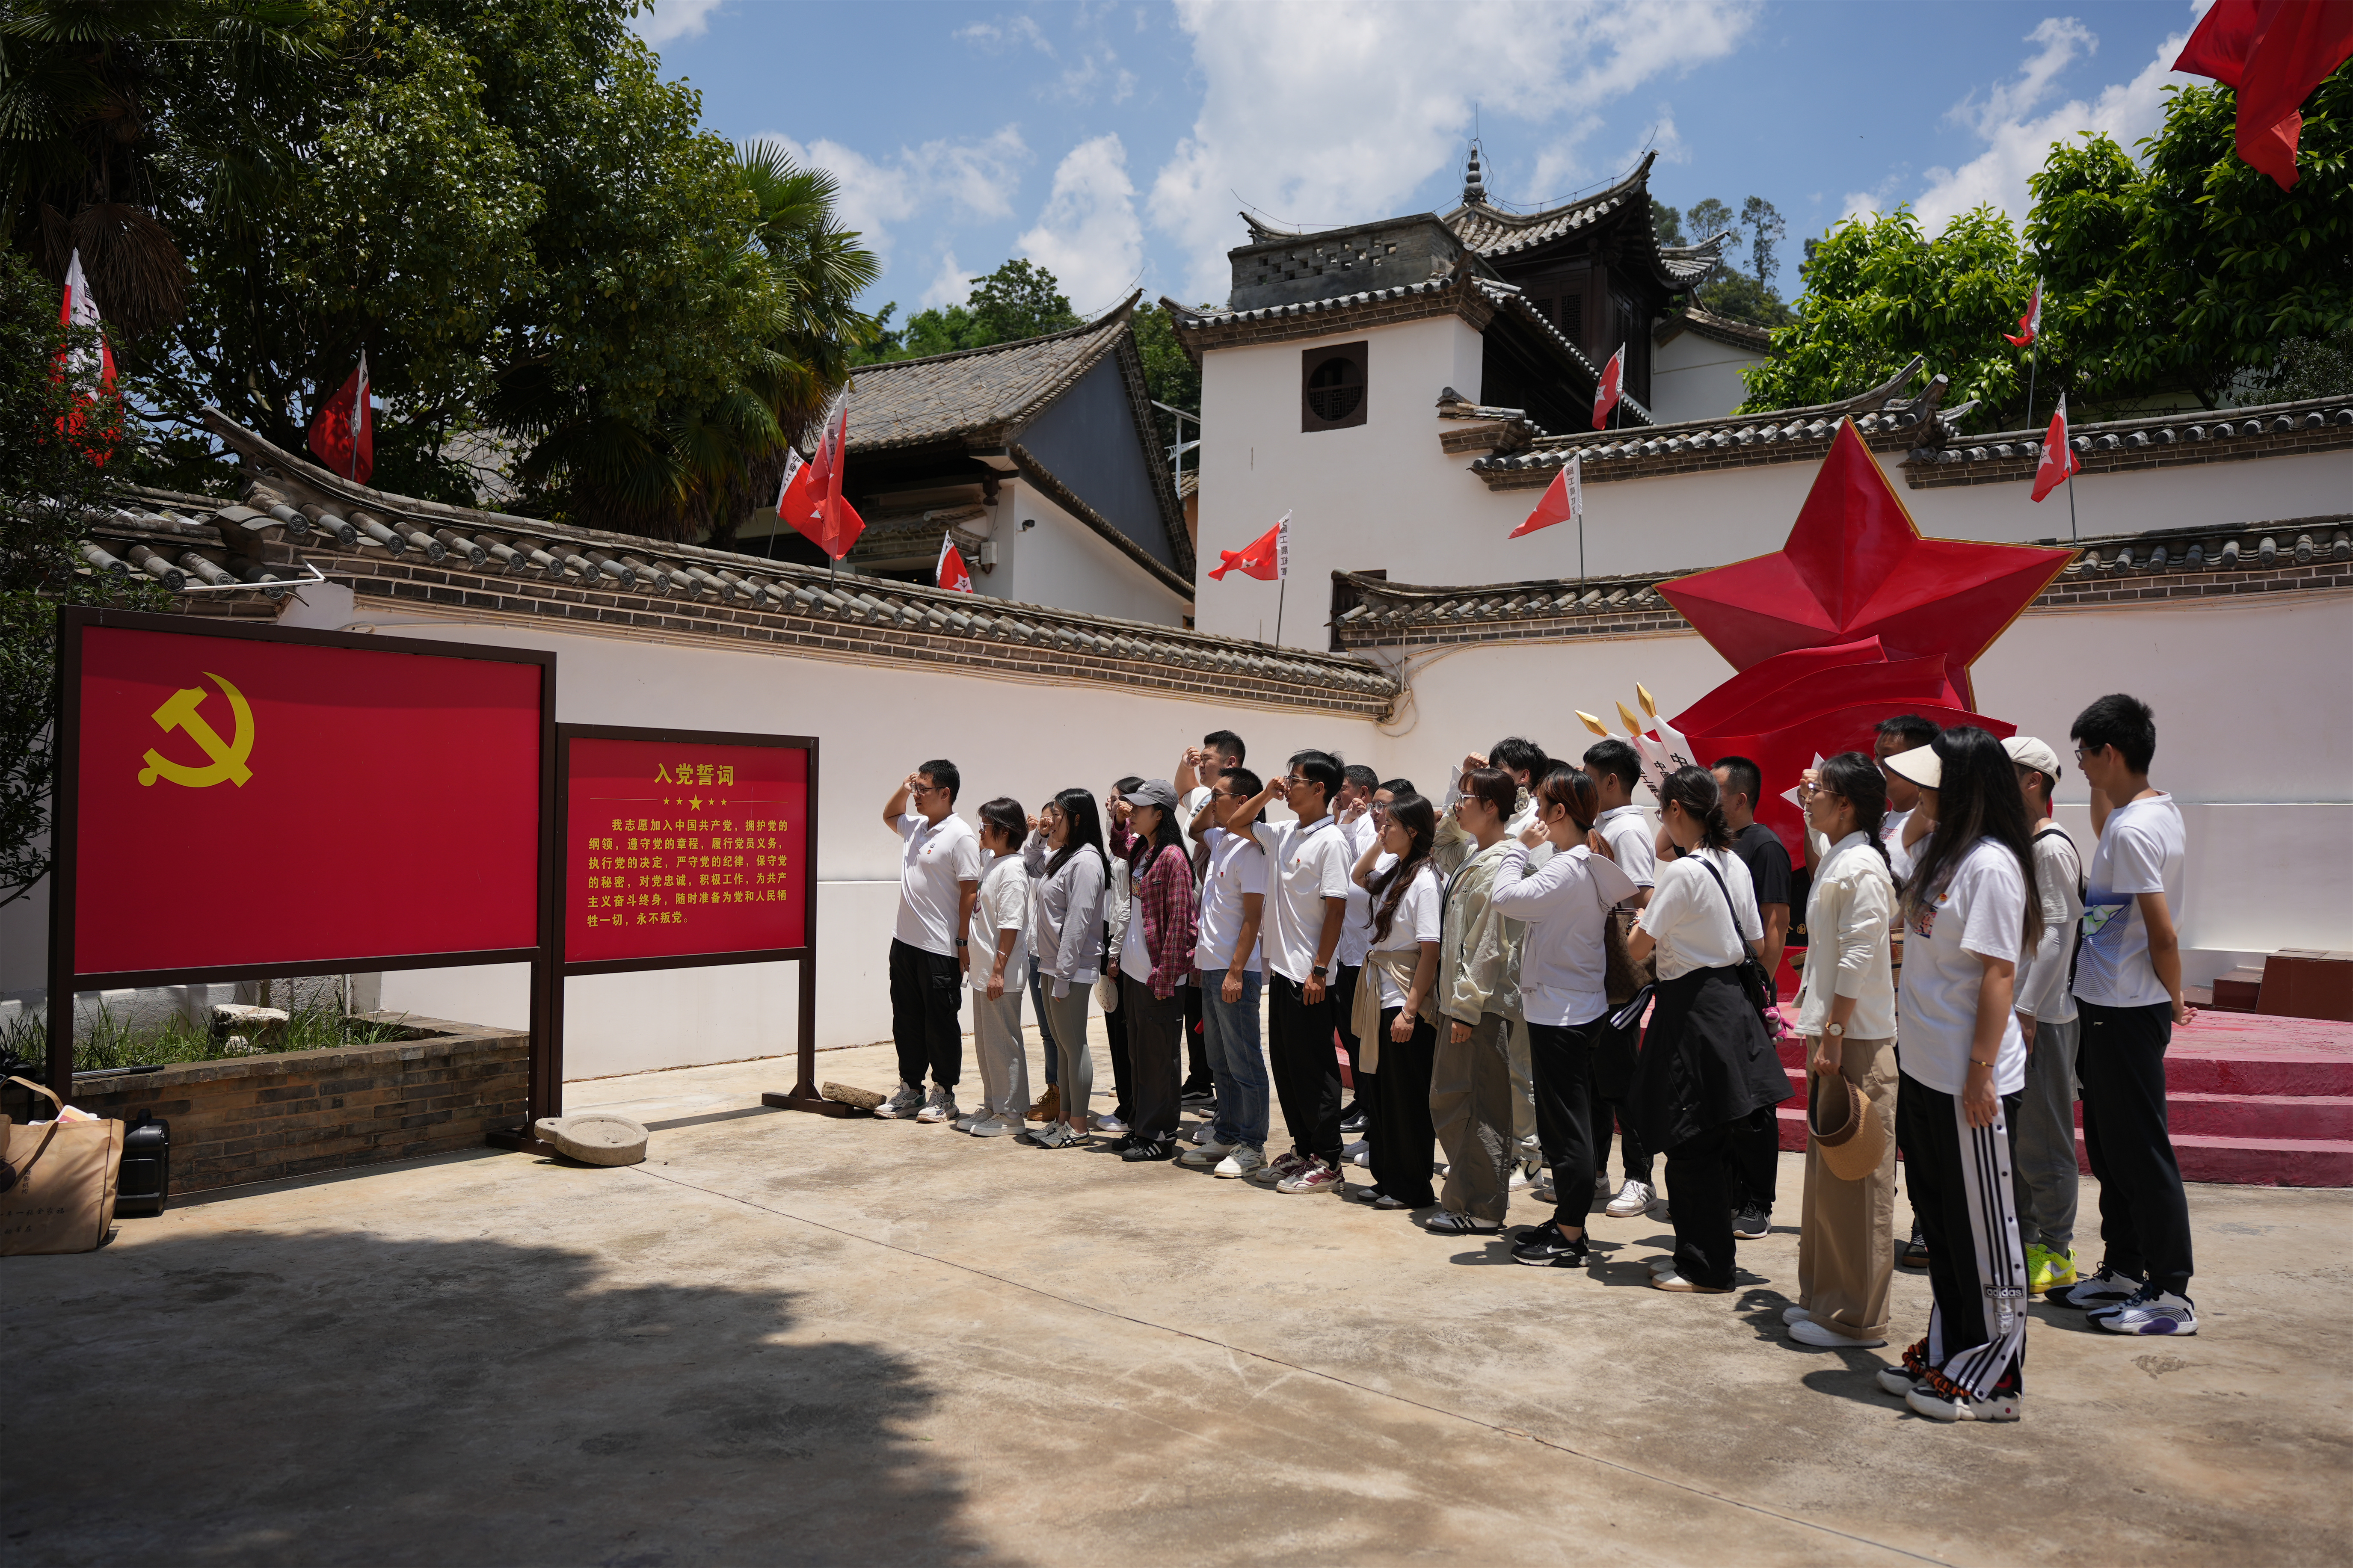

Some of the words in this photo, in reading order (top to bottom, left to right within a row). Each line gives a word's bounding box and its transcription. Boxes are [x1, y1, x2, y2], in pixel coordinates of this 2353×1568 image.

[654, 763, 733, 786] 入党誓词
[612, 819, 787, 831] 我志愿加入中国共产党，拥护党的
[589, 837, 782, 851] 纲领，遵守党的章程，履行党员义务，
[588, 855, 787, 870] 执行党的决定，严守党的纪律，保守党
[588, 872, 787, 889] 的秘密，对党忠诚，积极工作，为共产
[587, 889, 787, 908] 主义奋斗终身，随时准备为党和人民牺
[587, 911, 688, 927] 牲一切，永不叛党。
[1986, 1287, 2022, 1297] adidas
